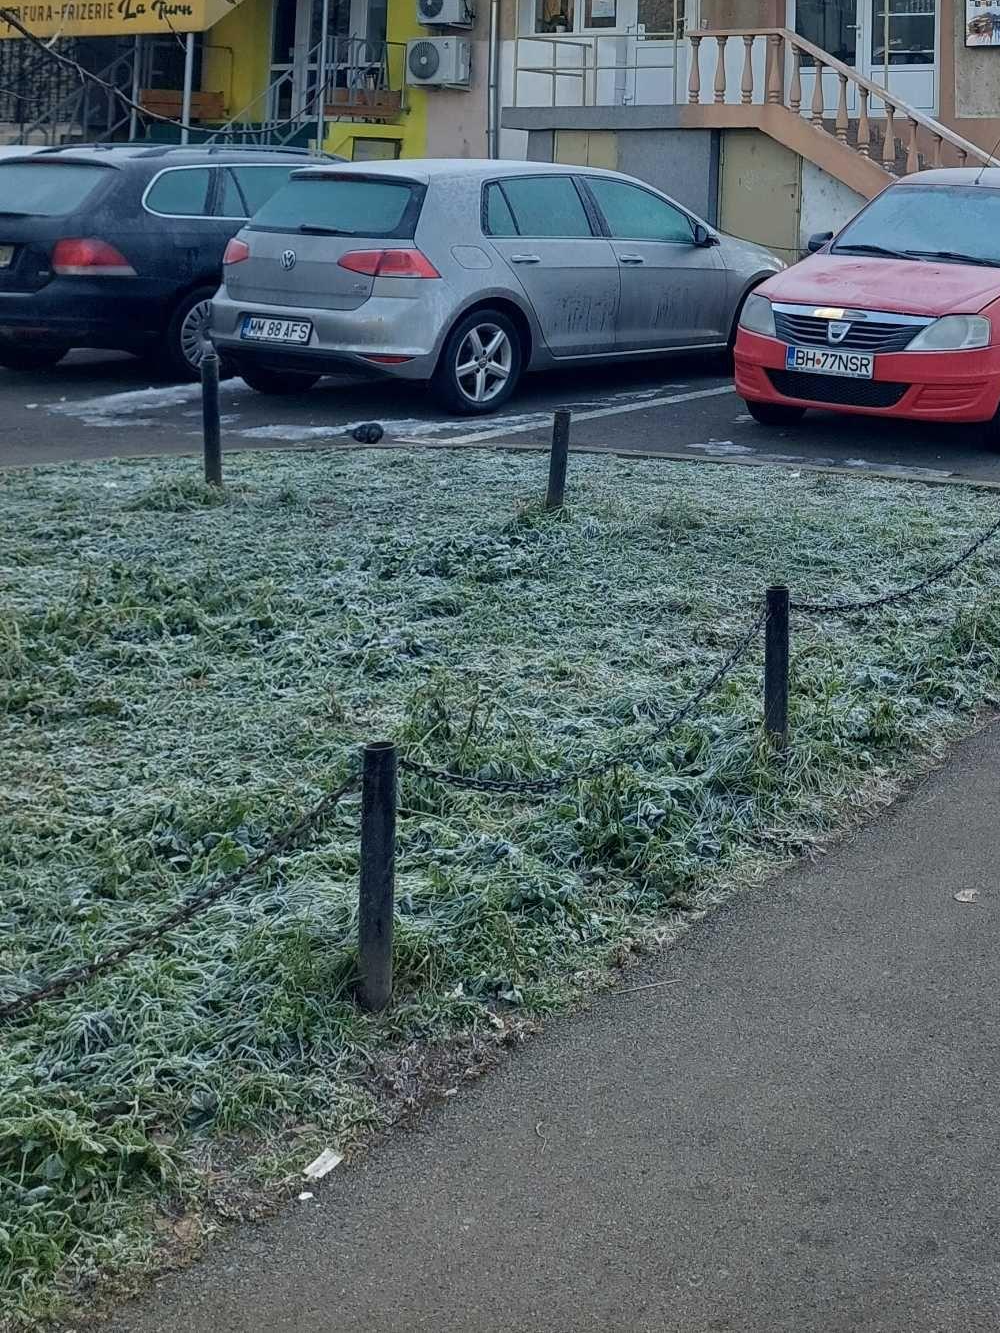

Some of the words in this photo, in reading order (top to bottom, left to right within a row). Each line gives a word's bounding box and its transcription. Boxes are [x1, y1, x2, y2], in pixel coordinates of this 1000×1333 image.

[267, 321, 282, 336] 88
[282, 322, 309, 339] AFS
[795, 350, 816, 367] BH
[820, 352, 870, 374] 77NSR
